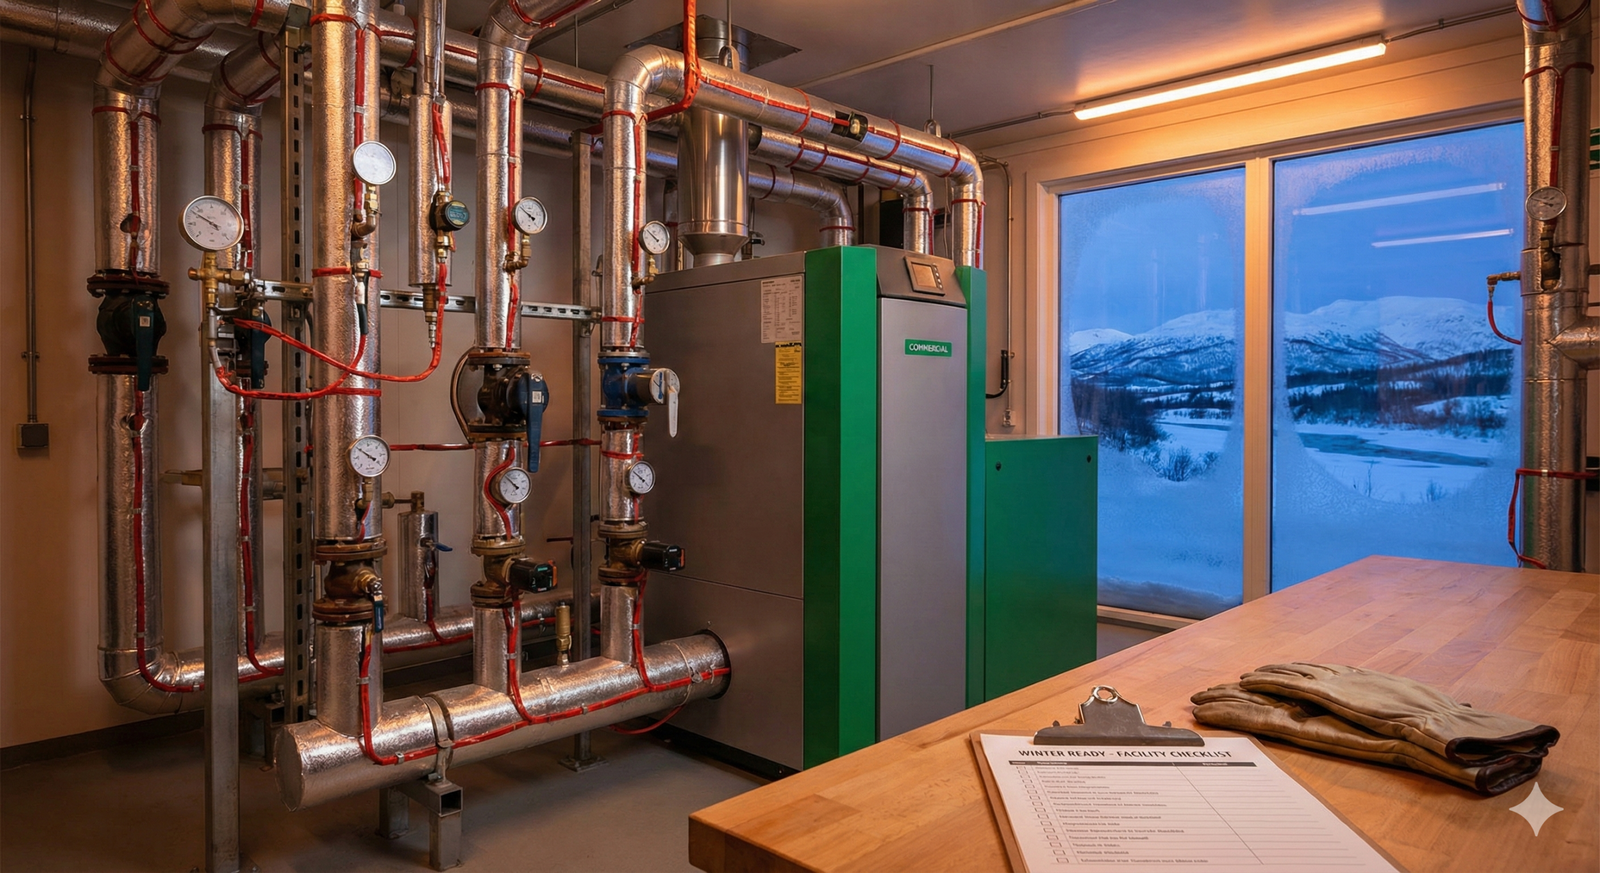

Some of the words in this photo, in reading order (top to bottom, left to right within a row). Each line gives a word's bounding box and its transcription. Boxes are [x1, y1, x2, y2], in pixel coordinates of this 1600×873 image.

[909, 343, 948, 353] COMMERCIAL
[1117, 750, 1167, 758] FACILITY
[1170, 750, 1232, 758] CHECKLIST
